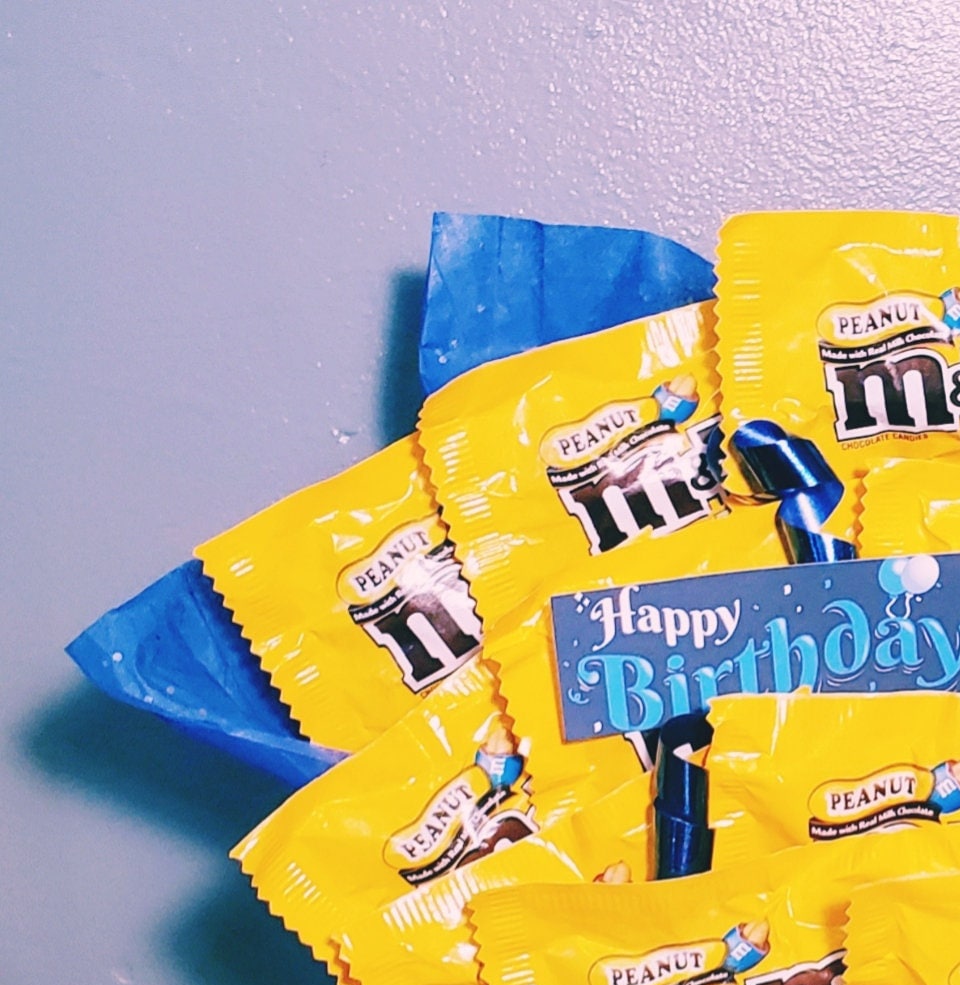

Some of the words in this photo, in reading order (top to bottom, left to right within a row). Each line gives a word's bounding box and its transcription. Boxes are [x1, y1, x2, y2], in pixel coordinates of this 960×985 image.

[839, 302, 921, 335] PEANUT
[558, 409, 638, 455] PEANUT
[841, 435, 889, 450] CHOCOLATE
[891, 432, 929, 445] CANDIES
[355, 531, 430, 592] PEANUT
[590, 584, 741, 651] Happy
[830, 776, 916, 810] PEANUT
[402, 783, 474, 859] PEANUT
[811, 826, 838, 837] Made
[838, 825, 858, 835] with
[858, 816, 878, 830] Real
[878, 810, 897, 822] Milk
[897, 806, 935, 817] Chocolate
